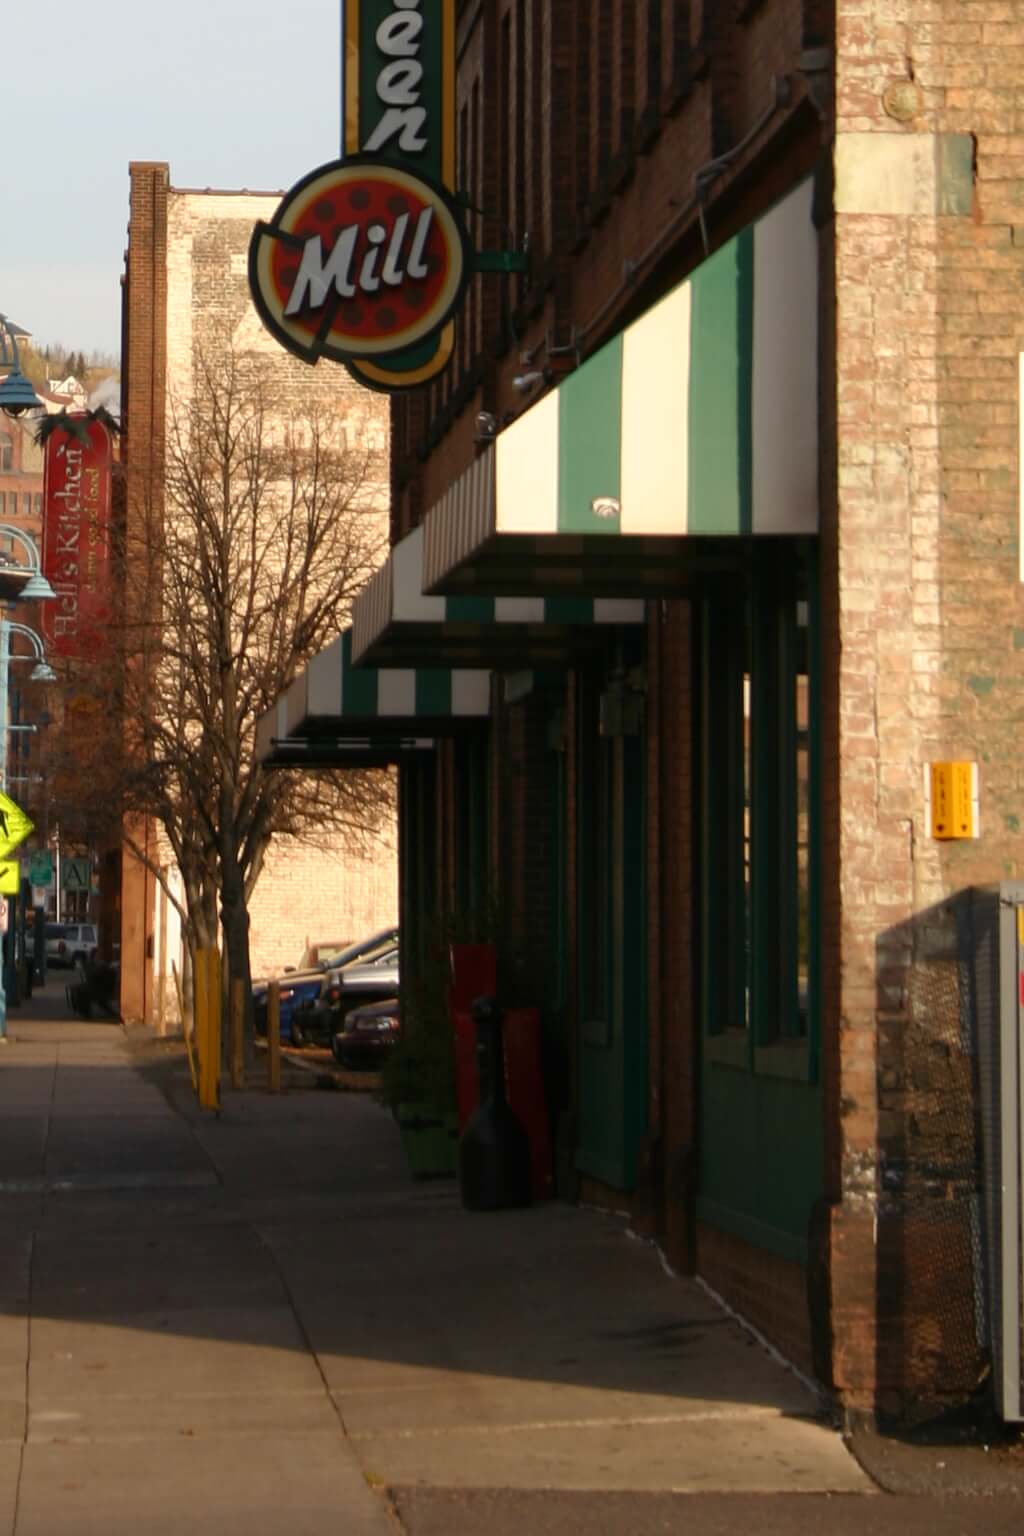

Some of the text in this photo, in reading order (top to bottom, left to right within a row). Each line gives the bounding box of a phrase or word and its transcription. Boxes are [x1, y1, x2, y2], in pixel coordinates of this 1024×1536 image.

[282, 205, 434, 316] Mill
[84, 467, 100, 502] food
[53, 448, 83, 638] Hell's Kitchen
